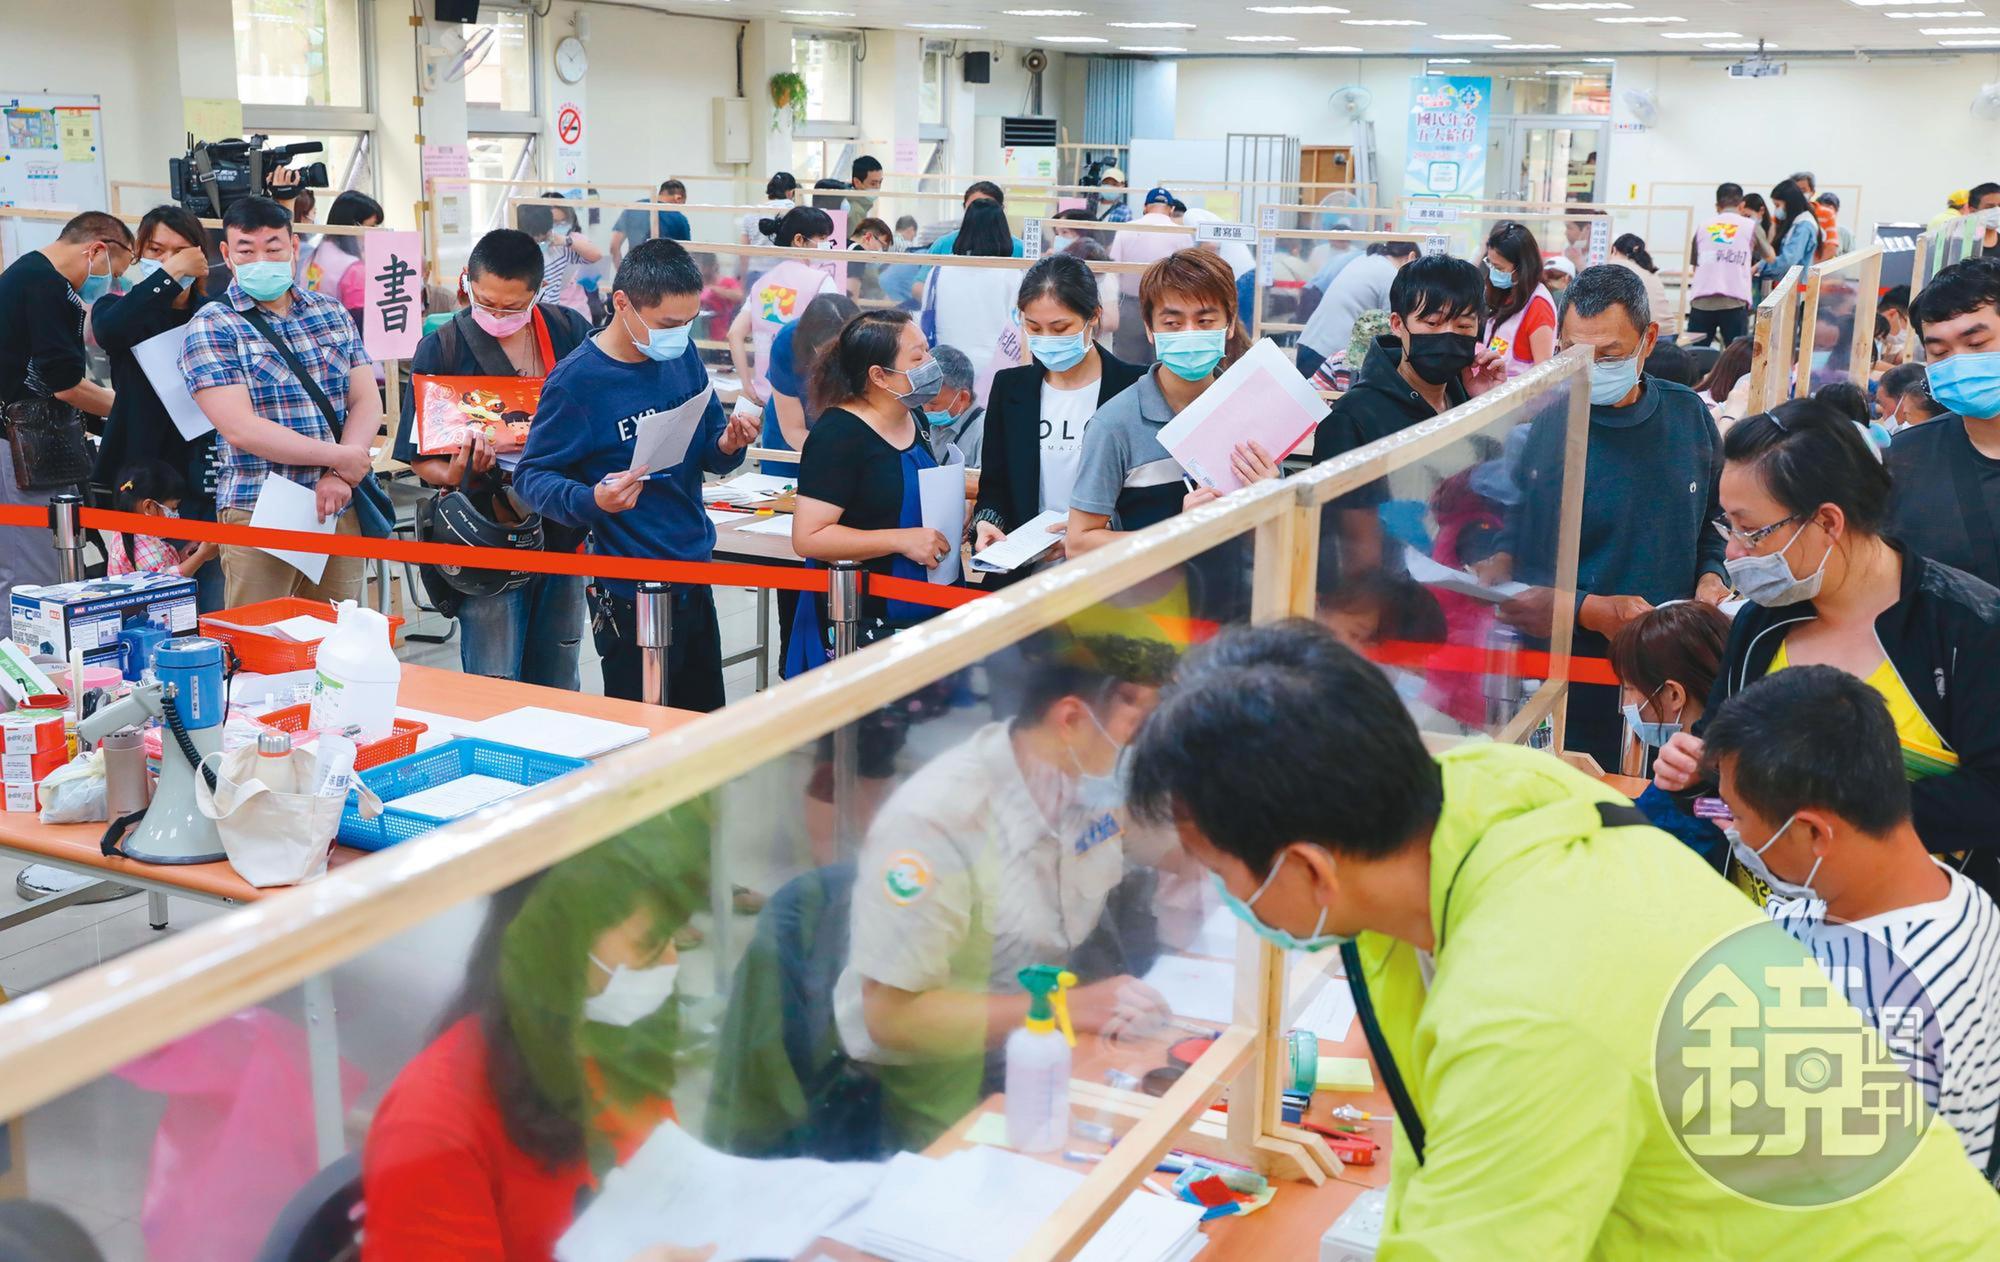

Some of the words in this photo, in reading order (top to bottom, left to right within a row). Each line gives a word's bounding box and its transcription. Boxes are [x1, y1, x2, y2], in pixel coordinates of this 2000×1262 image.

[1213, 226, 1242, 238] 書寫區
[374, 253, 417, 333] 書
[1039, 419, 1090, 440] OL
